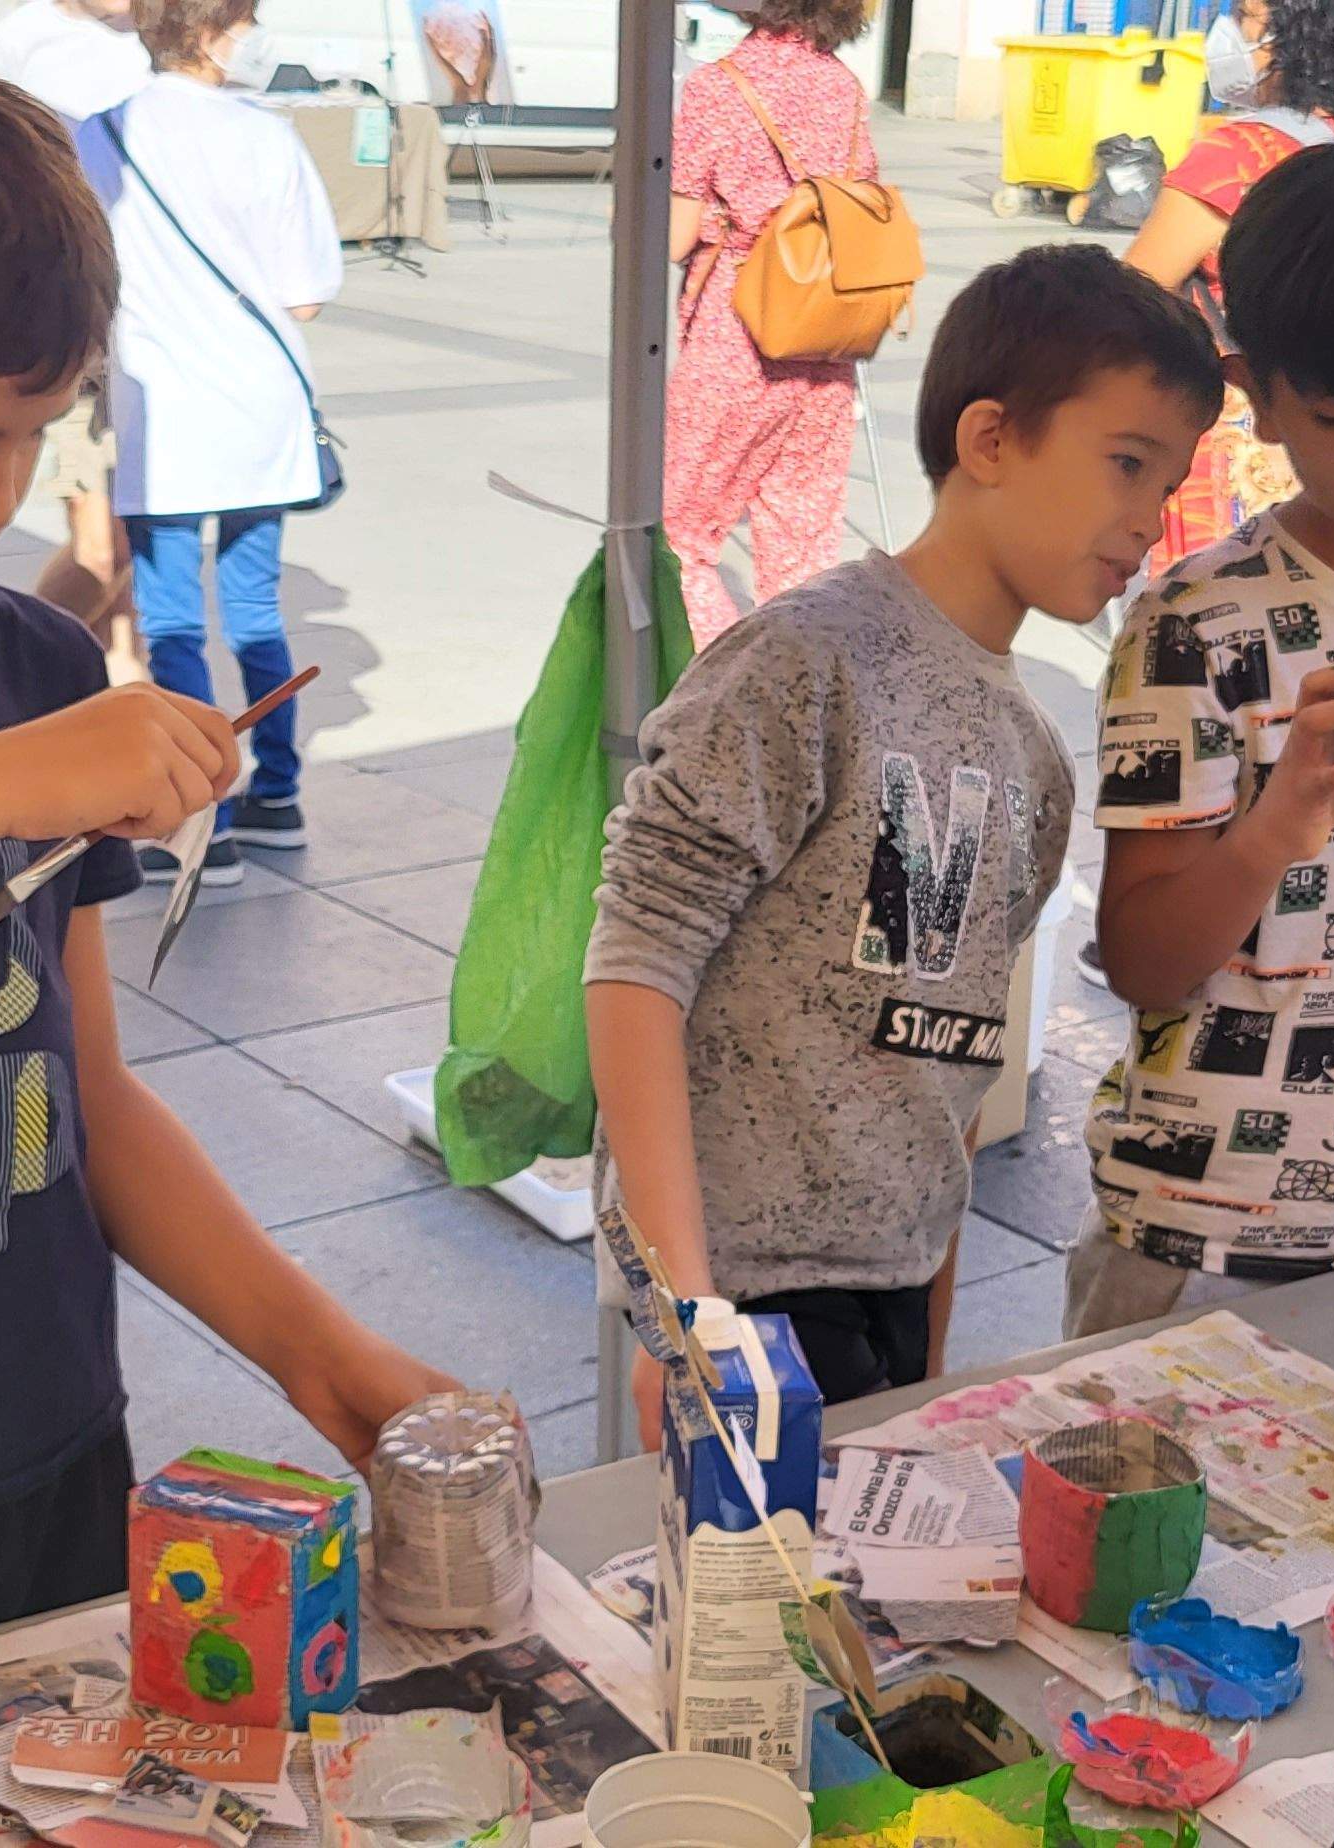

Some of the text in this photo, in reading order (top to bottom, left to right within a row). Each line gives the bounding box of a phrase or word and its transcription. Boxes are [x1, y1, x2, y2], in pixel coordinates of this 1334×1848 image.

[1273, 607, 1302, 627] 50
[1285, 869, 1313, 888] 50
[930, 1015, 971, 1054] OF
[1241, 1111, 1275, 1129] 50
[872, 1459, 916, 1537] Orozco en la
[849, 1518, 866, 1534] El
[144, 1720, 249, 1747] LOS
